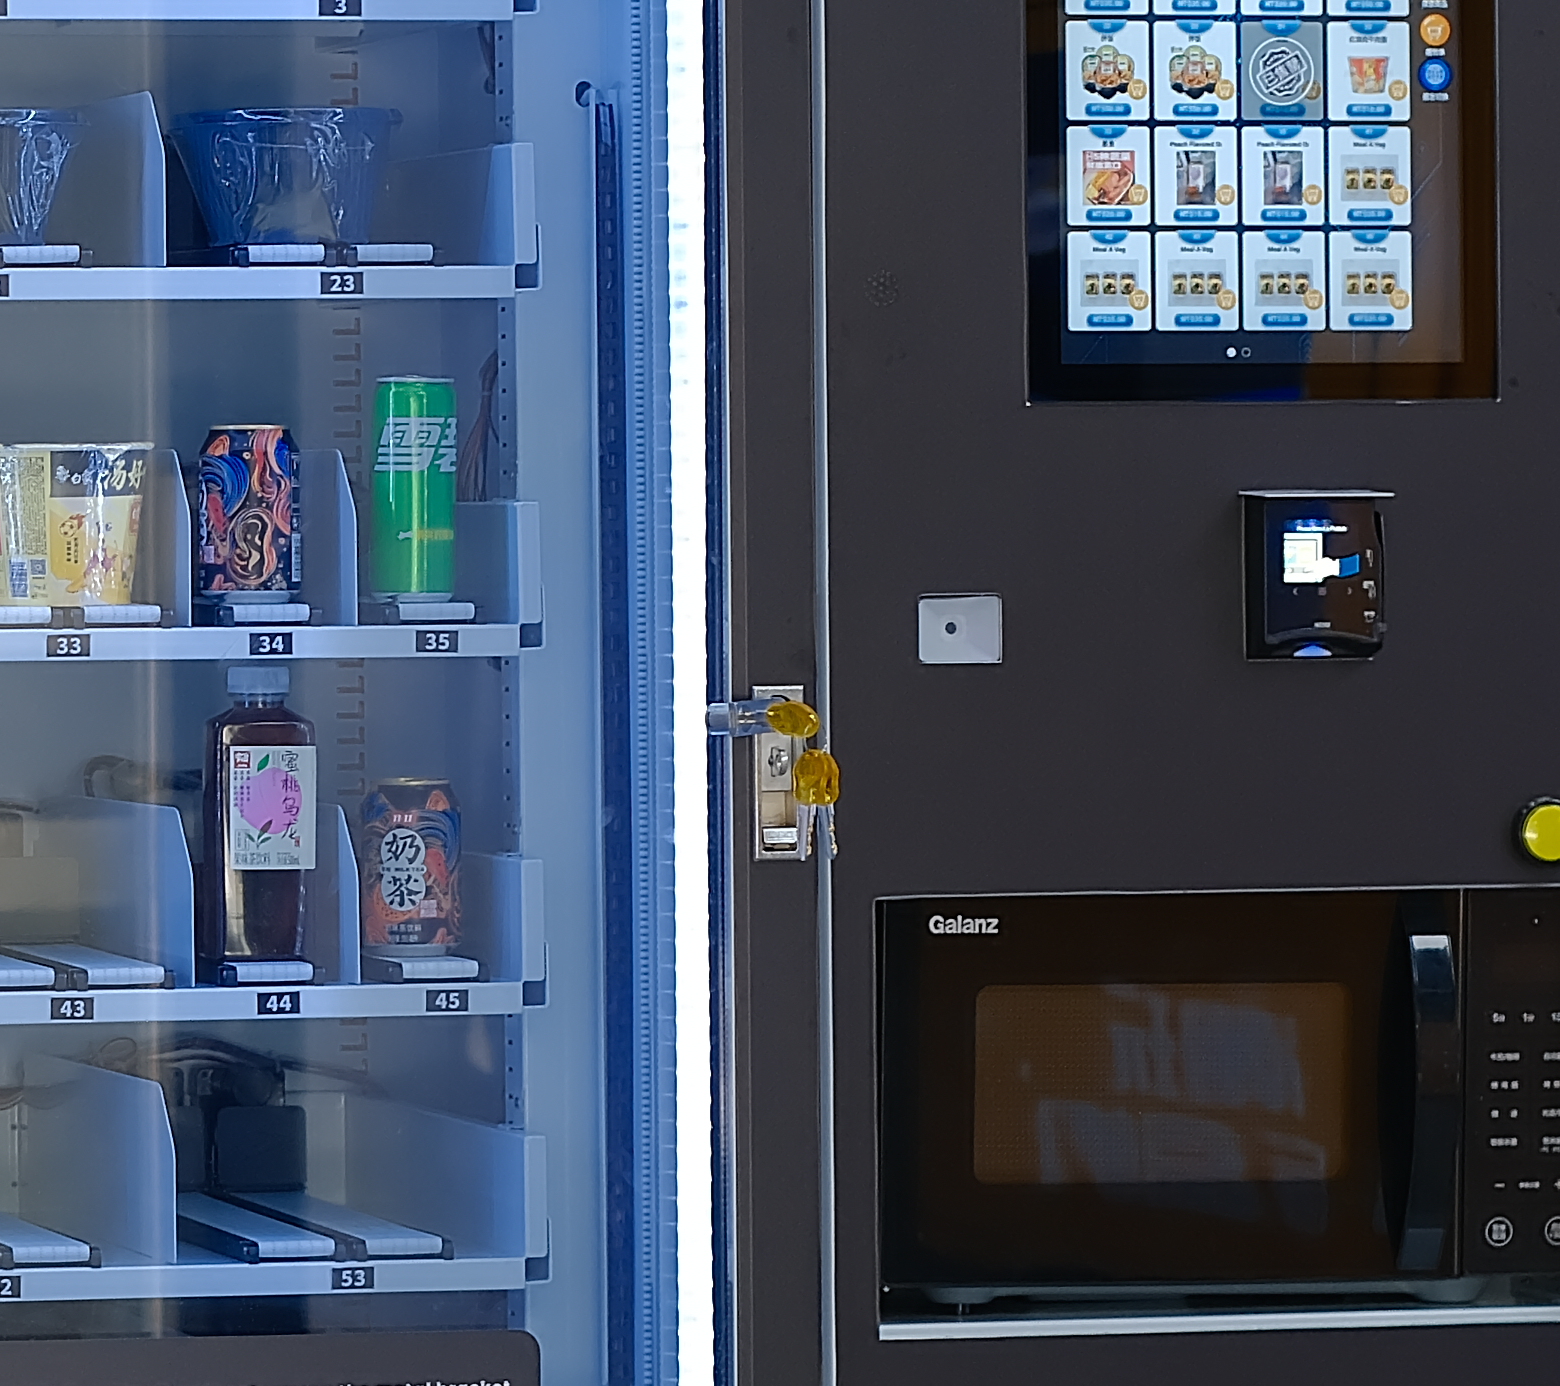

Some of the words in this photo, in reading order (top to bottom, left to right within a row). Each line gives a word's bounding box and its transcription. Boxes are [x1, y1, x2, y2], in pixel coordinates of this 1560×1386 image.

[329, 274, 355, 291] 23
[55, 635, 82, 654] 33
[258, 634, 285, 651] 34
[424, 632, 450, 649] 35
[281, 750, 301, 840] 蜜桃乌龙
[929, 915, 998, 933] Galanz
[59, 999, 85, 1017] 43
[265, 994, 291, 1011] 44
[434, 992, 460, 1009] 45
[340, 1269, 365, 1286] 53
